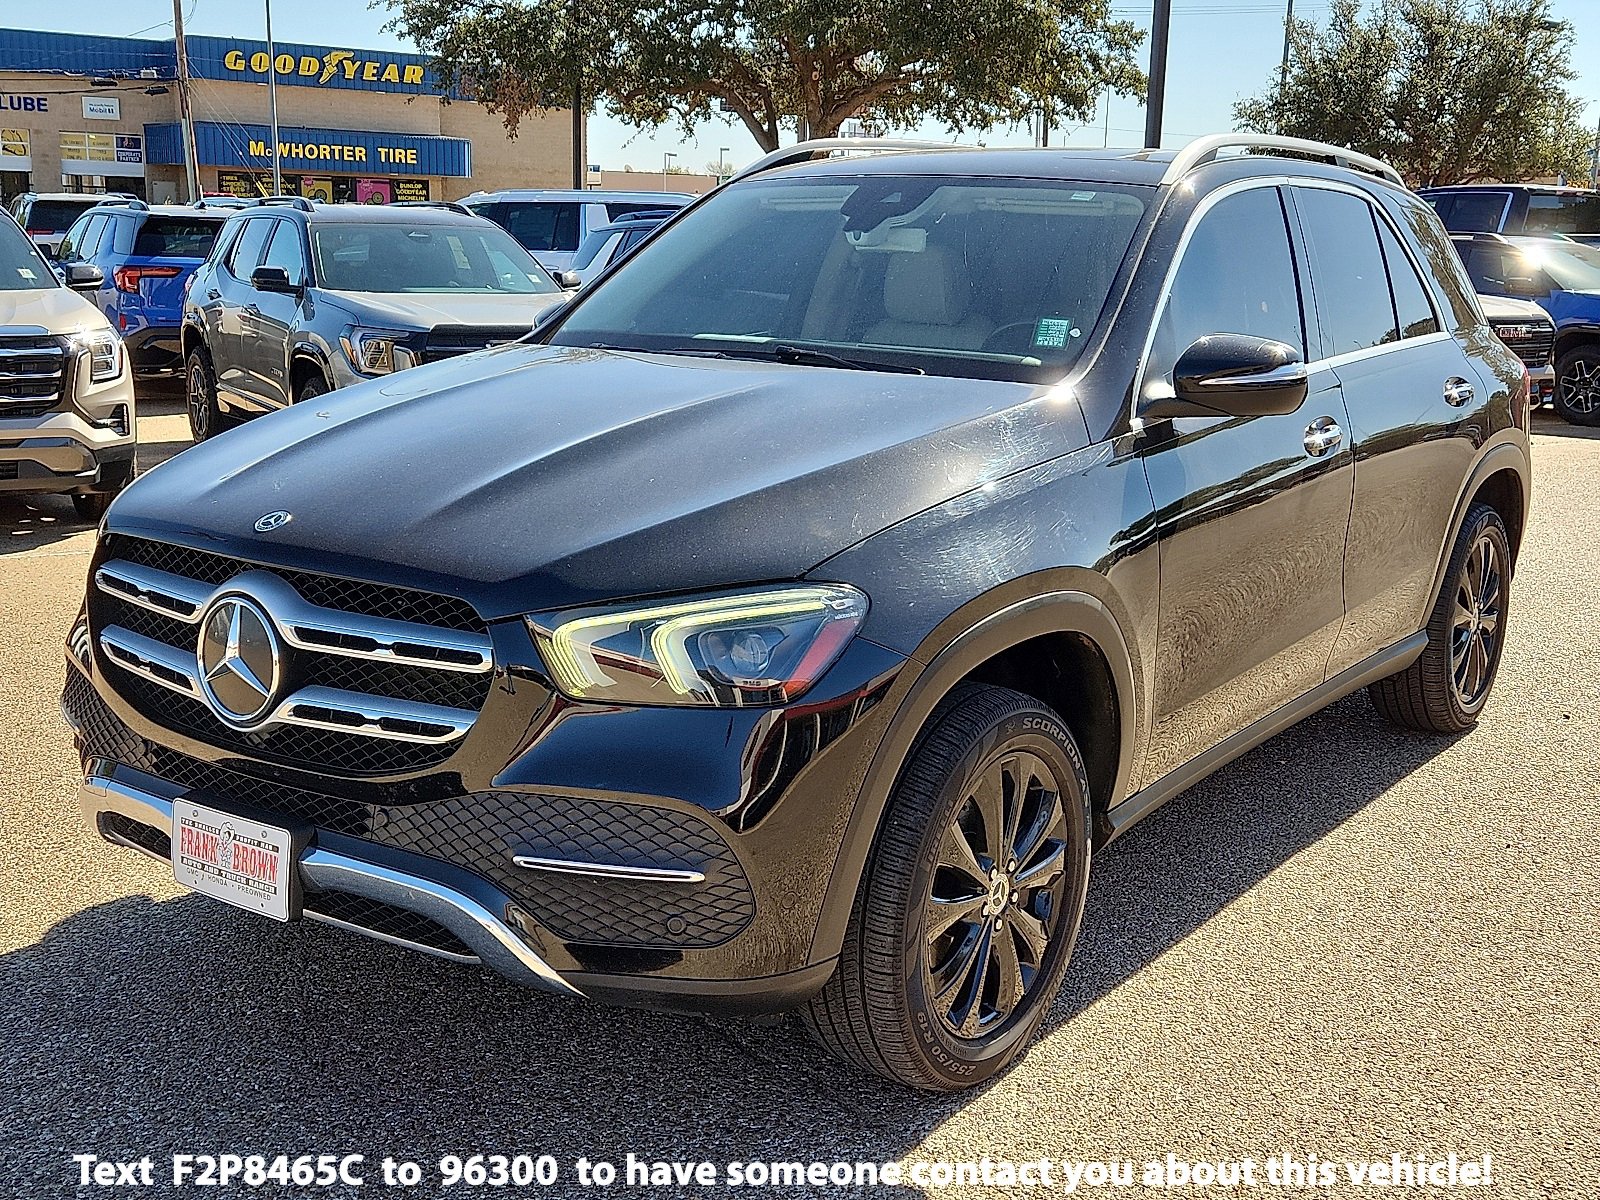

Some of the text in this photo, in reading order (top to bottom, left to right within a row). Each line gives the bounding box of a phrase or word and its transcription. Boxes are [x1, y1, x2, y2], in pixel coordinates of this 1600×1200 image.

[224, 50, 425, 85] GOODYEAR
[0, 95, 49, 113] LUBE
[249, 140, 418, 165] McWHORTER TIRE
[395, 188, 427, 196] GOODYEAR
[397, 194, 426, 202] MICHELIN
[1022, 717, 1081, 769] SCORPION
[180, 826, 279, 885] FRANK BROWN
[182, 857, 276, 894] AUTO AND TRUCK RANCH
[186, 867, 271, 901] GMC HONDA PREOWNED
[931, 1046, 977, 1076] 255/50
